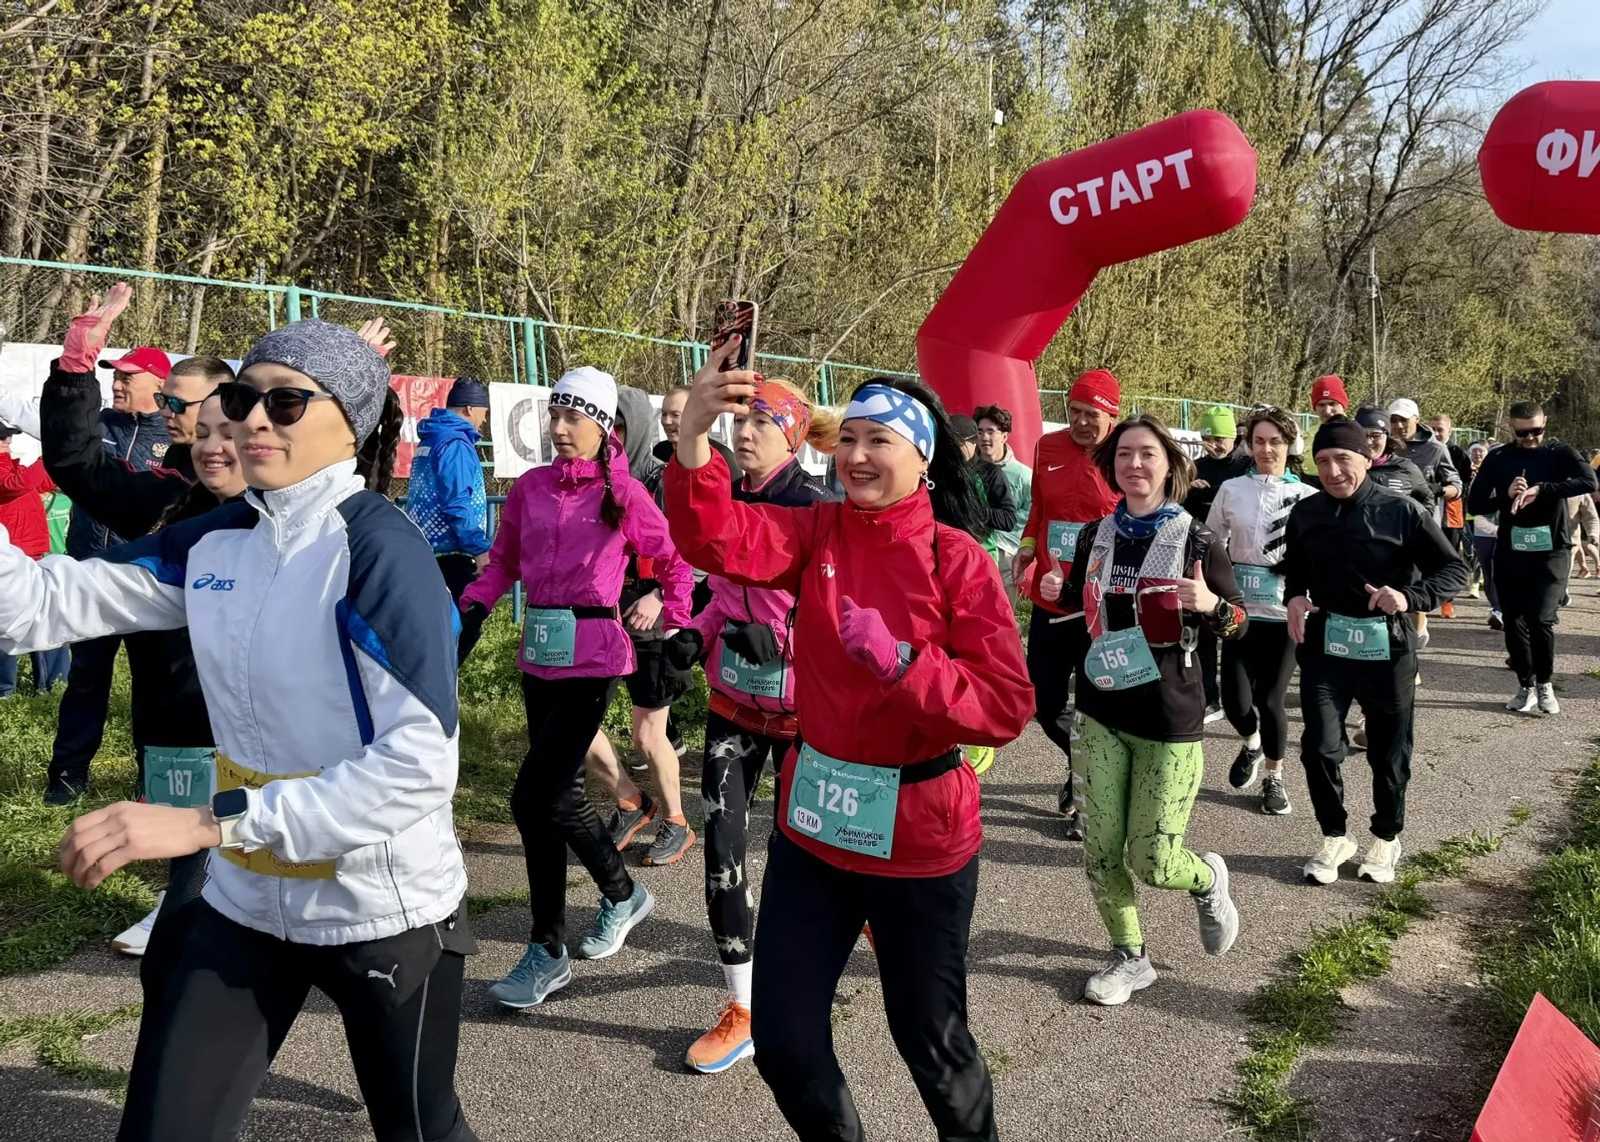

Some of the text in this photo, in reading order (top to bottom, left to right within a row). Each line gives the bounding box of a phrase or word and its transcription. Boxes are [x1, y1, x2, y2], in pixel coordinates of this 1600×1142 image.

[1050, 148, 1194, 226] СТАРТ
[549, 392, 614, 431] RSPORT
[1061, 532, 1075, 547] 68
[1524, 534, 1537, 543] 60
[1242, 575, 1260, 589] 118
[534, 624, 548, 643] 75
[1346, 628, 1364, 644] 70
[1098, 647, 1129, 670] 156
[166, 769, 192, 797] 187
[817, 779, 859, 817] 126
[797, 810, 805, 824] 13
